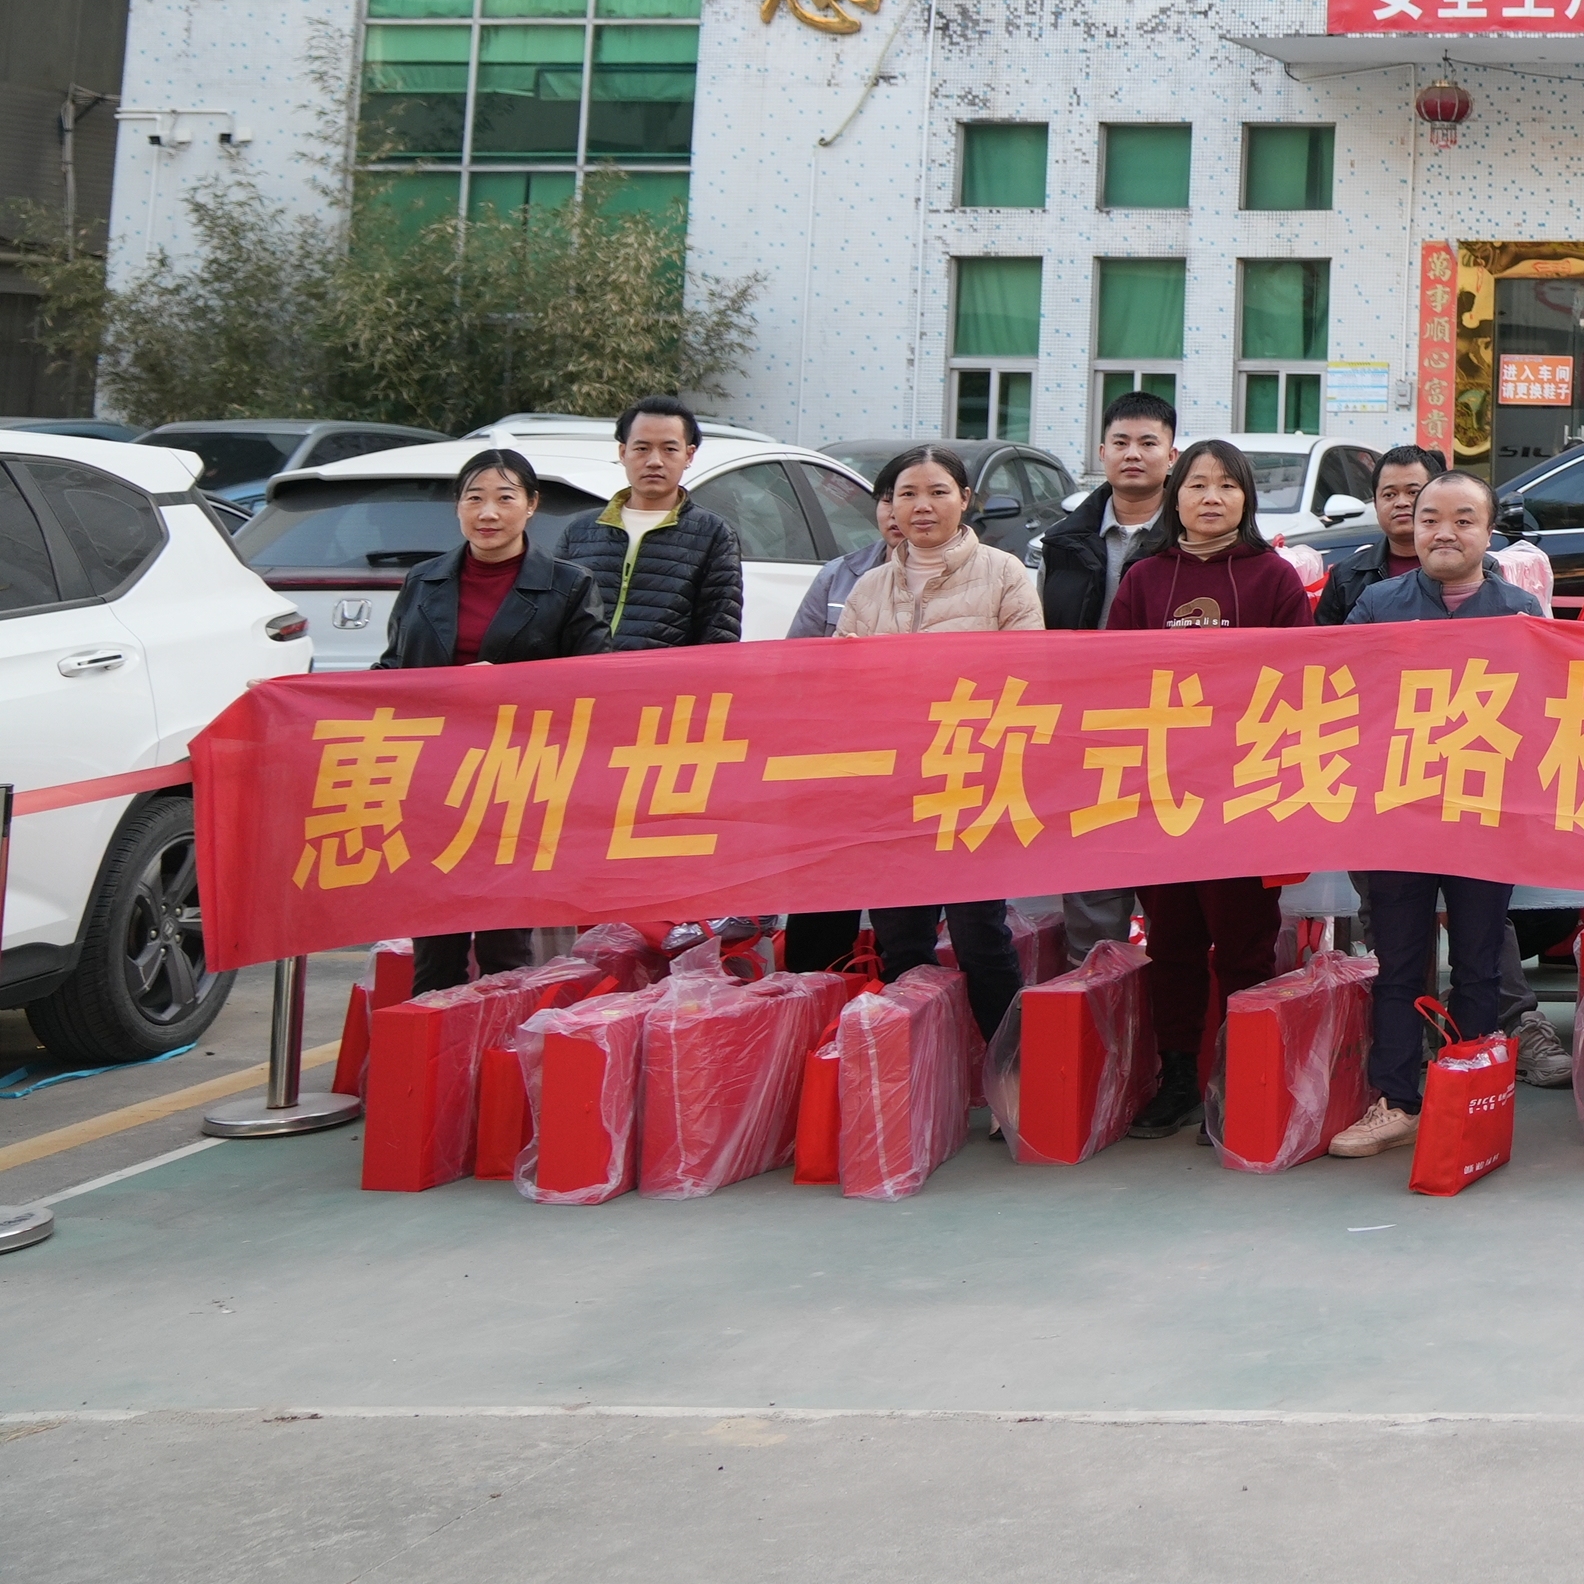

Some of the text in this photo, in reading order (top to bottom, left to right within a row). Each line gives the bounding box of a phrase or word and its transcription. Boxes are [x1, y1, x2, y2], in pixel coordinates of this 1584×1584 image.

[1421, 252, 1452, 451] 萬事順心富貴
[1502, 364, 1571, 383] 进入车间
[1502, 382, 1570, 400] 请更换鞋子
